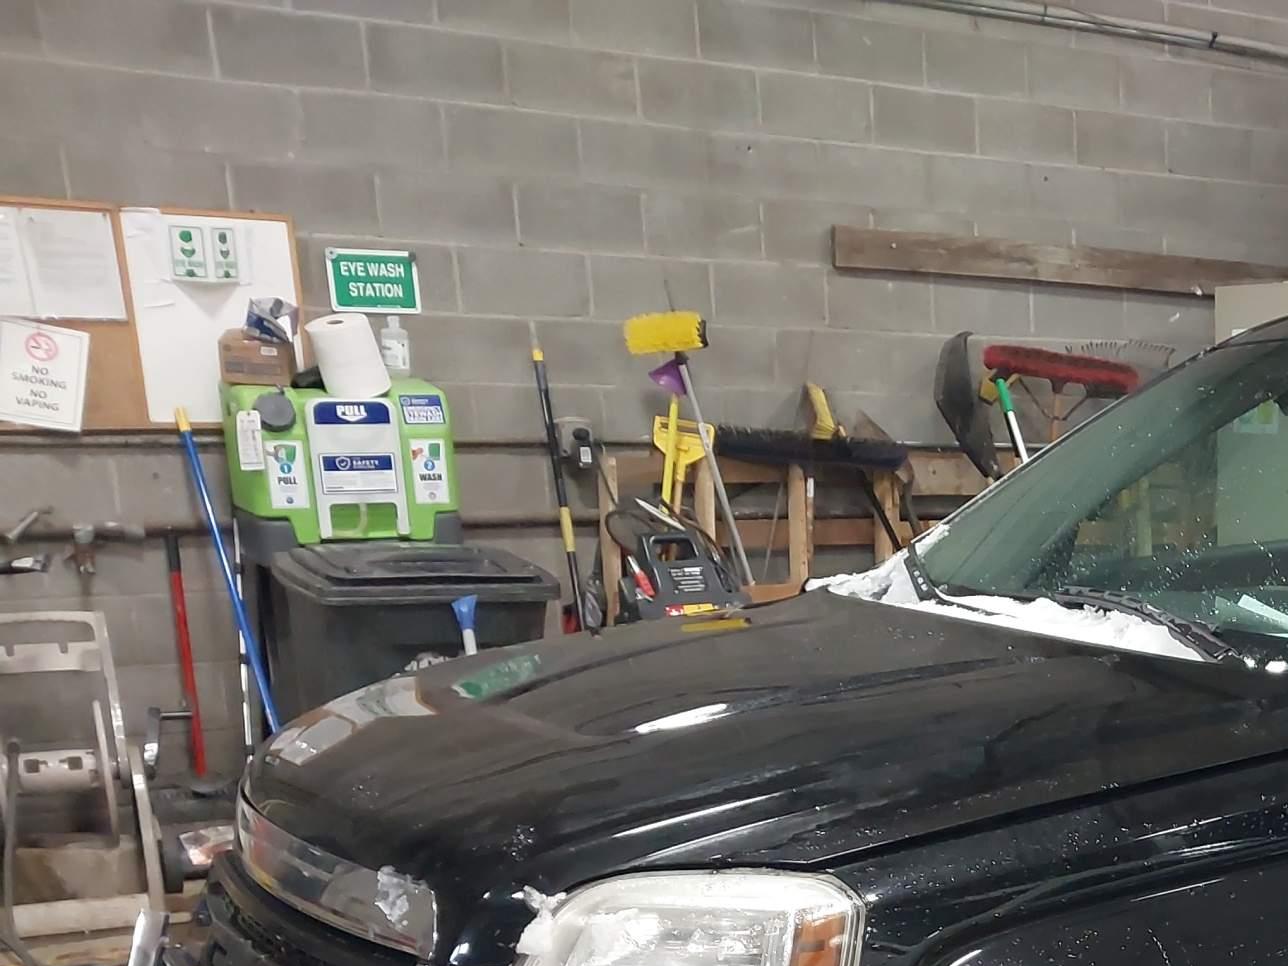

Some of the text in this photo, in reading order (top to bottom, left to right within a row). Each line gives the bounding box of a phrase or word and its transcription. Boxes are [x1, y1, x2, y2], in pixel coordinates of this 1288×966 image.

[340, 261, 405, 278] EYE WASH
[348, 282, 404, 298] STATION
[31, 364, 49, 376] NO
[11, 371, 67, 389] SMOKING
[30, 388, 48, 399] NO
[16, 395, 60, 412] VAPING
[336, 404, 367, 416] PULL
[277, 475, 298, 485] PULL
[419, 472, 443, 481] WASH
